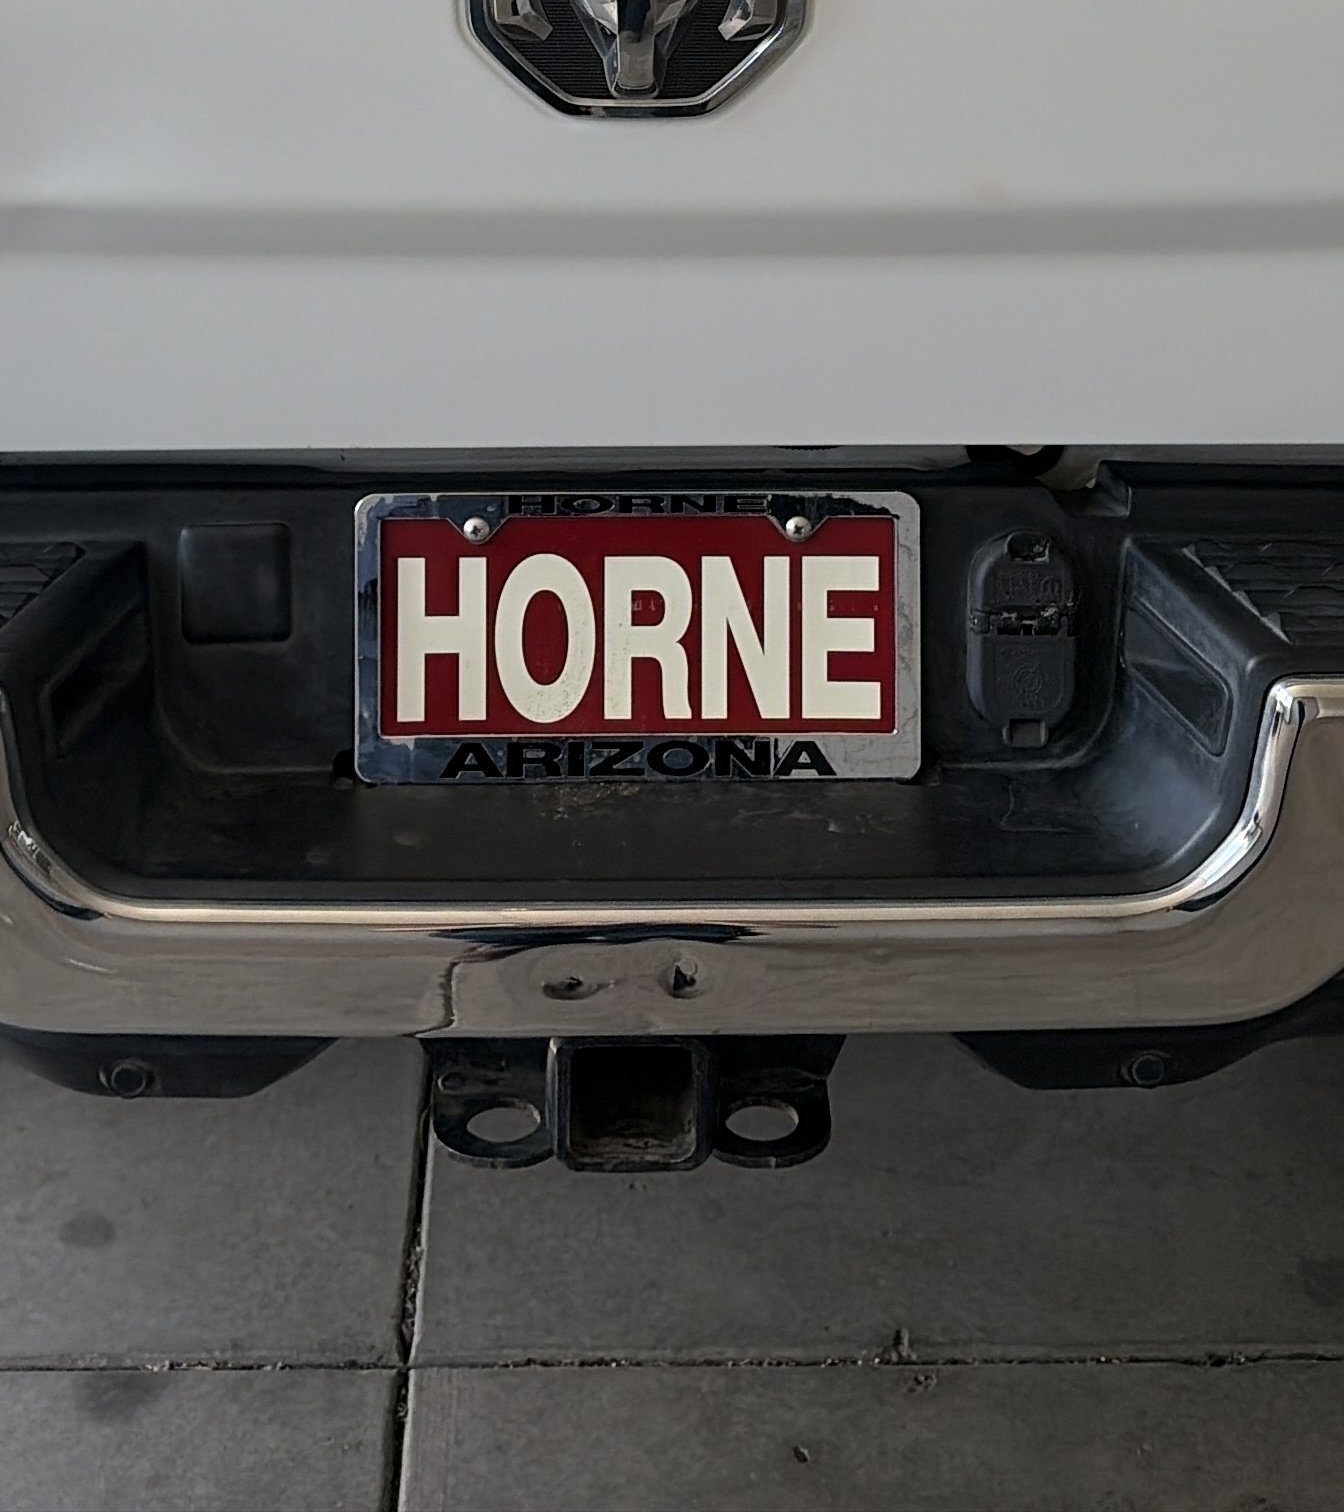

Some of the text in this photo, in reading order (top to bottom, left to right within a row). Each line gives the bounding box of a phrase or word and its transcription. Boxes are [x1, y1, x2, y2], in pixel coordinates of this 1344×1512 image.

[508, 494, 768, 514] HORNE
[396, 554, 882, 723] HORNE
[439, 739, 838, 779] ARIZONA
